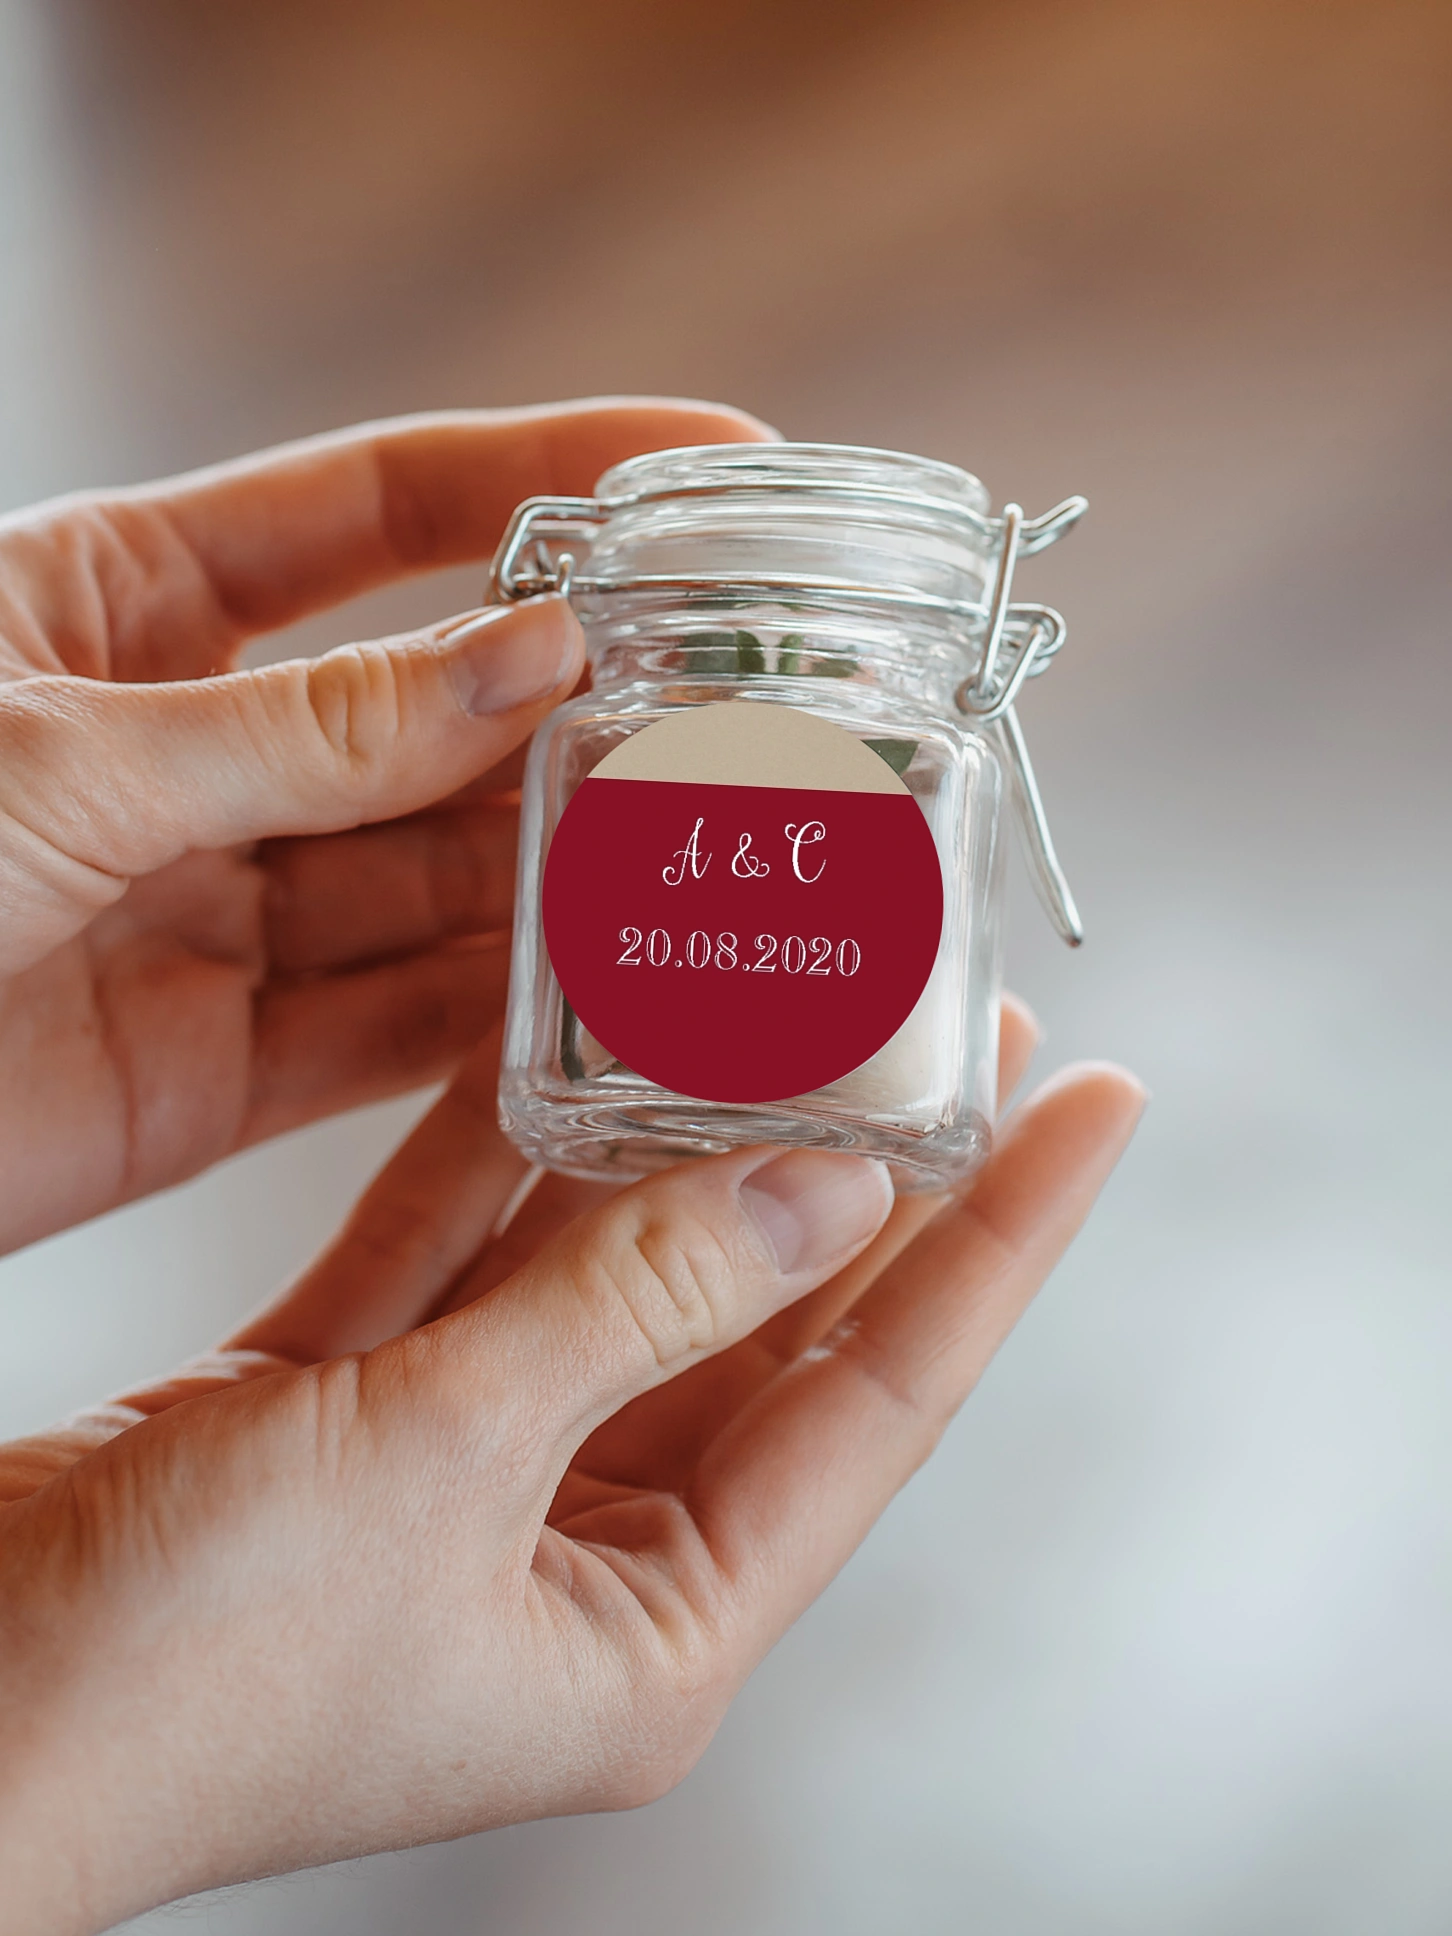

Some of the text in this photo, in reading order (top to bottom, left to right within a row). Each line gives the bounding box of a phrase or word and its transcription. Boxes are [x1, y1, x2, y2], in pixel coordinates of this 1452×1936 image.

[662, 817, 827, 886] A & C
[615, 926, 862, 977] 20.08.2020
